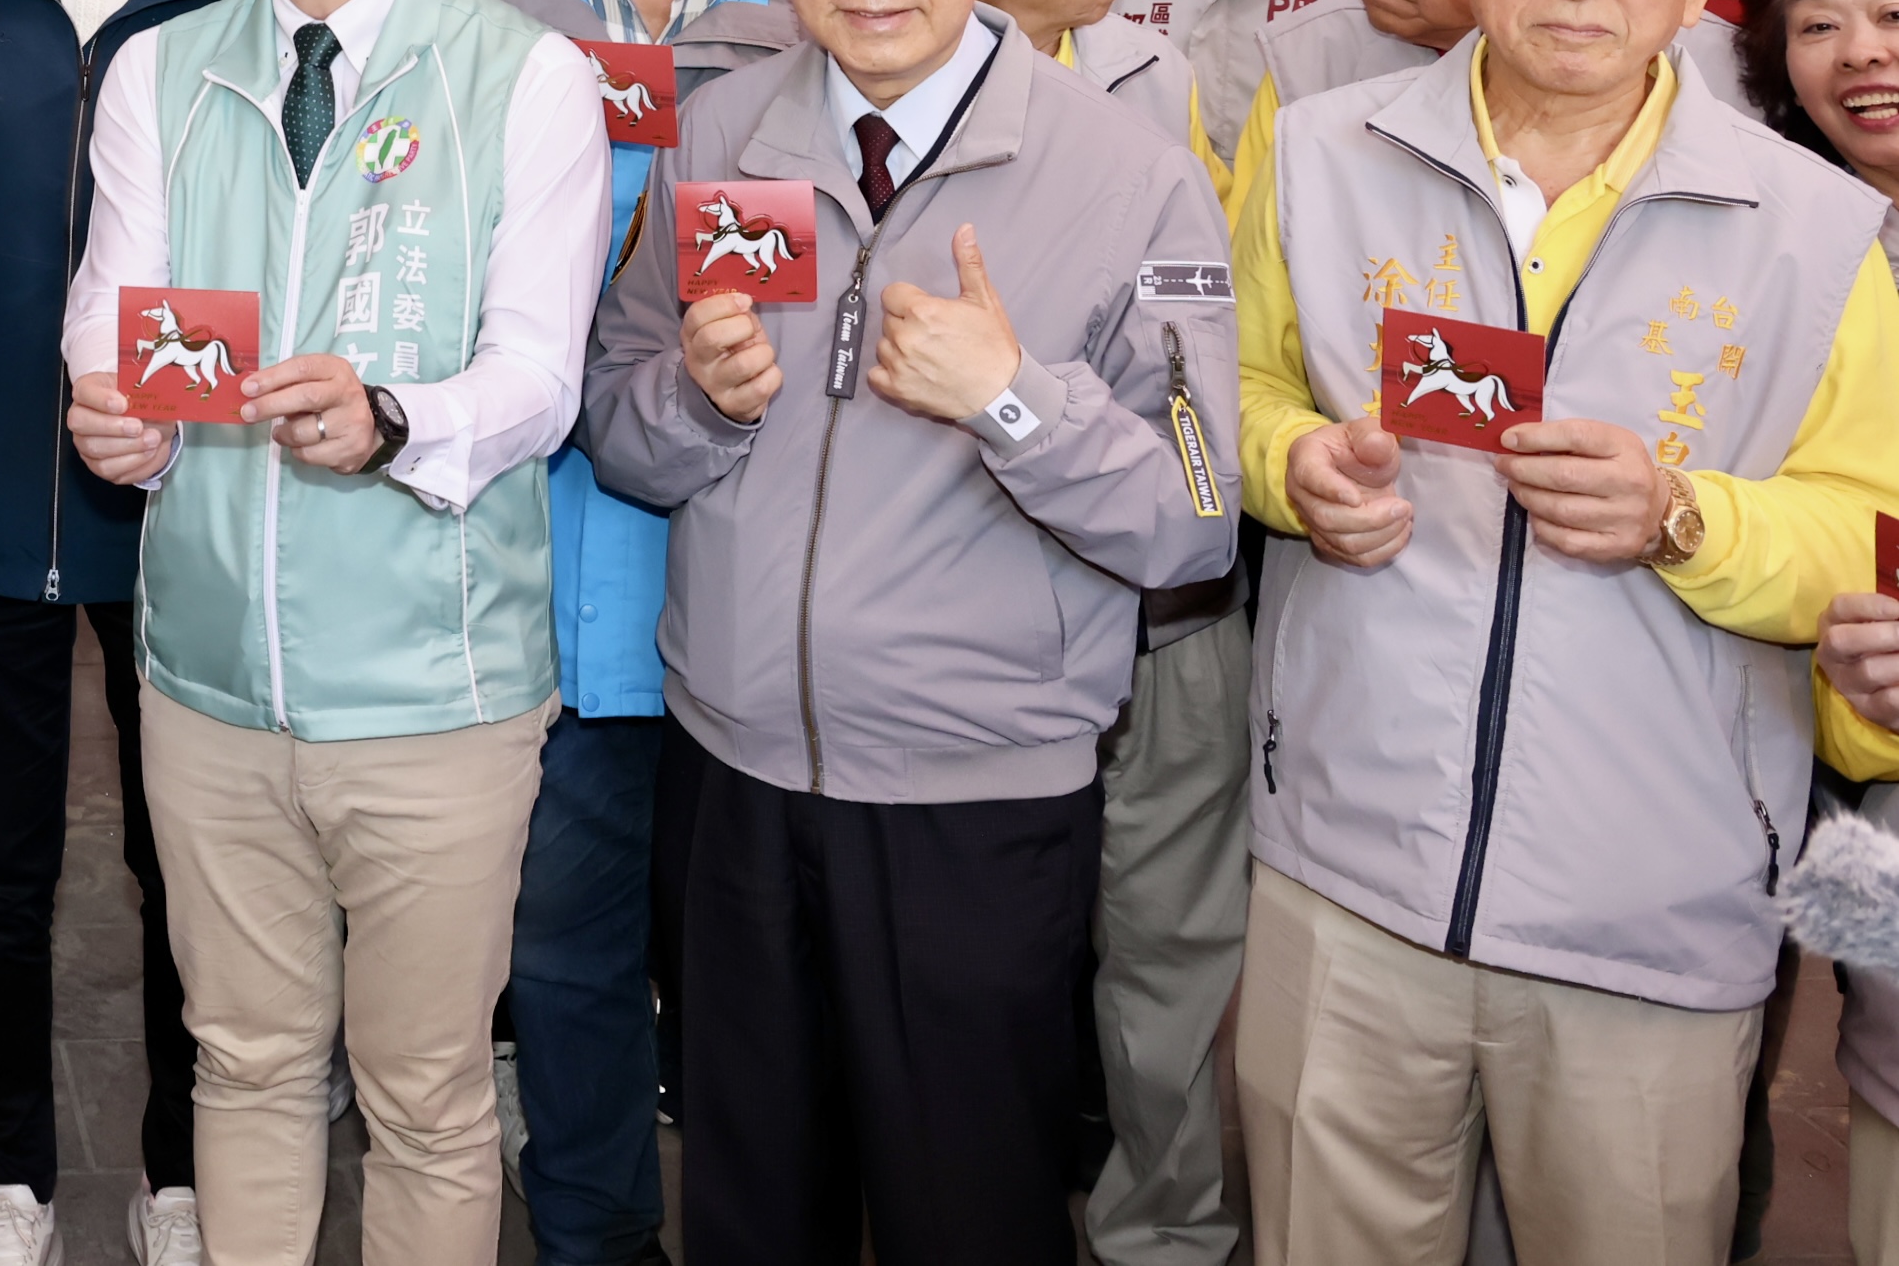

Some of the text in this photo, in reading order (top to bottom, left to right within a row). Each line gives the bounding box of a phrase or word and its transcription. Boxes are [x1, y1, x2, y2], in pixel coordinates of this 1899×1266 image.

[389, 199, 431, 380] 立法委員
[1425, 234, 1462, 312] 主任
[833, 310, 859, 390] Team Taiwan
[1178, 415, 1215, 513] TIGERAIR TAIWAN
